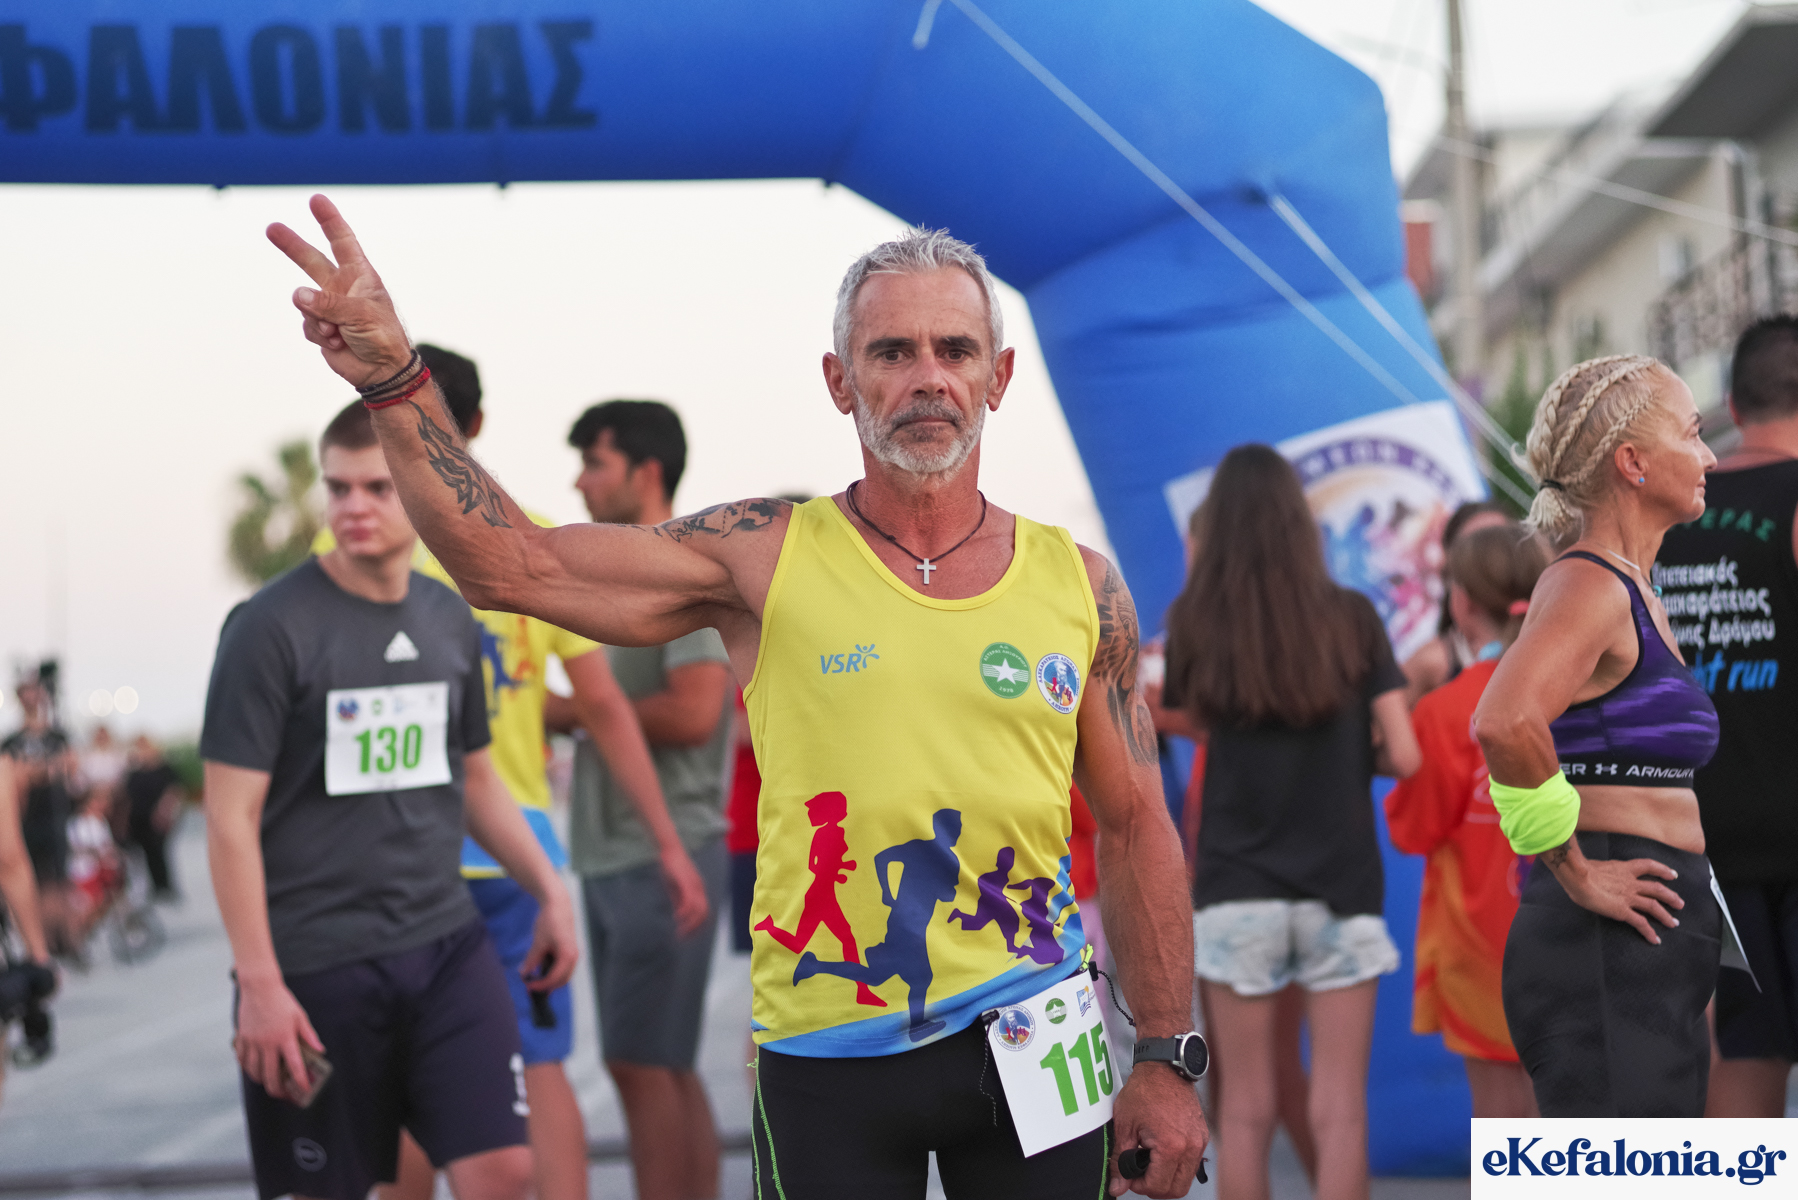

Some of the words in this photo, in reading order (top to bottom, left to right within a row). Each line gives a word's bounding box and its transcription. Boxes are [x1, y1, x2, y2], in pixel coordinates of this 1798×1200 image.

[820, 652, 862, 675] VSR
[1726, 658, 1779, 692] run
[355, 723, 423, 773] 130
[1039, 1020, 1114, 1117] 115
